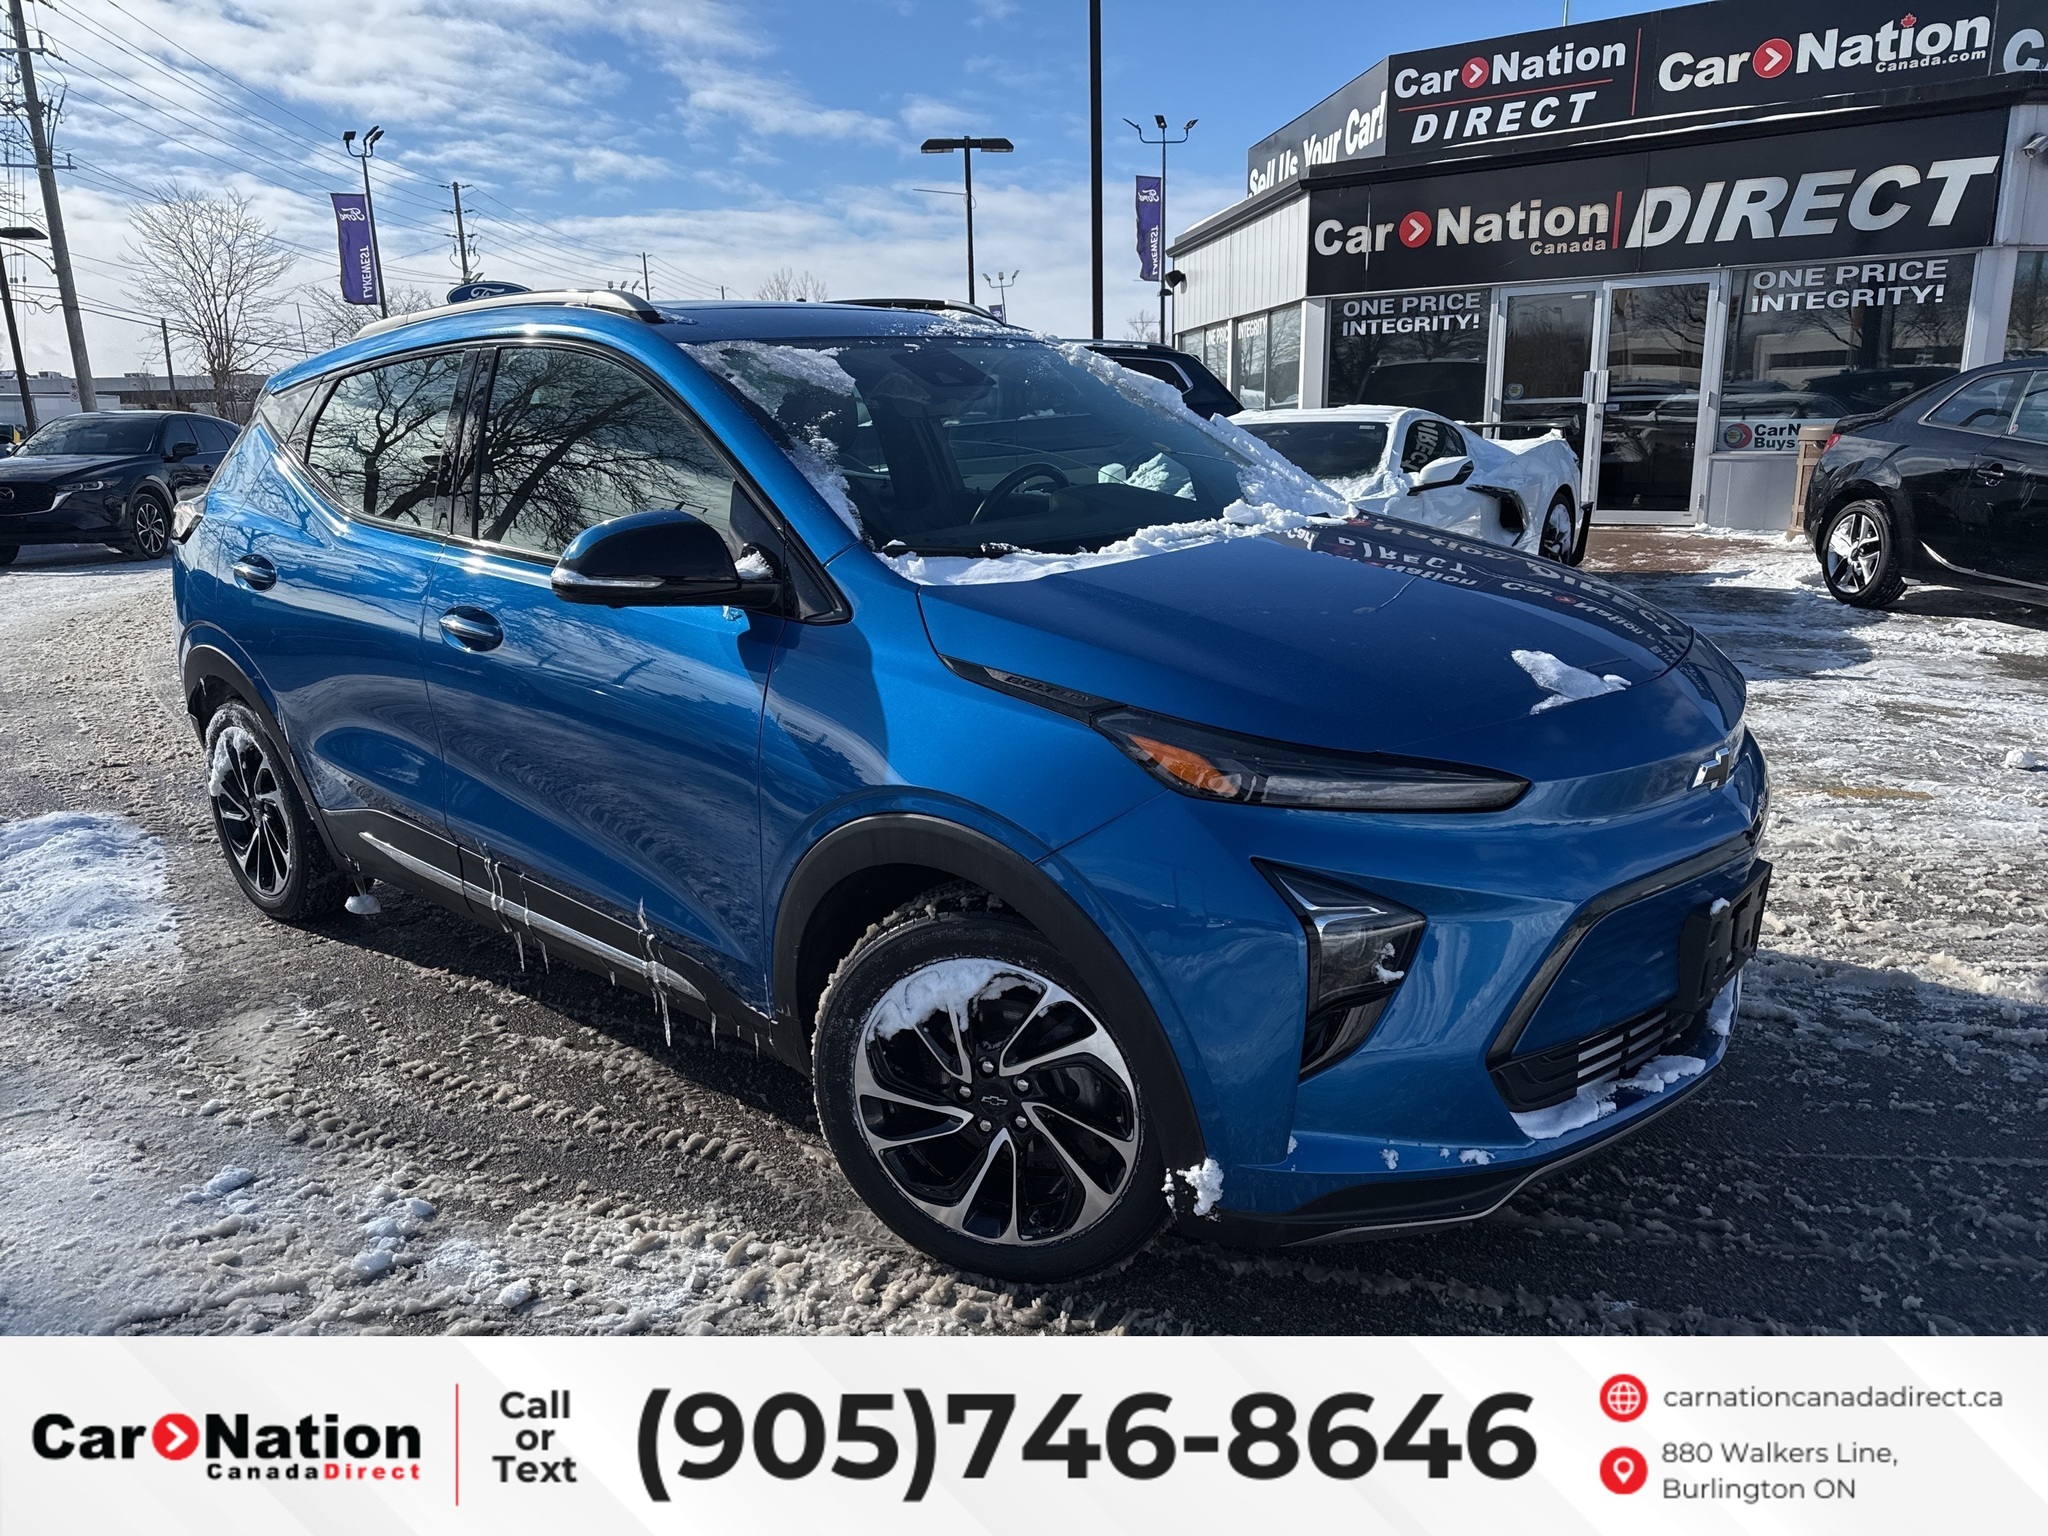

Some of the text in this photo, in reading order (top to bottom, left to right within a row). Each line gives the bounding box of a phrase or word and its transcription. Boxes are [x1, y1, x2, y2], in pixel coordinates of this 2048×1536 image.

[1658, 15, 1991, 92] Car Nation
[1875, 48, 1987, 74] Canada.com
[1394, 42, 1627, 98] Car Nation
[1303, 128, 1342, 168] Your
[1345, 89, 1387, 155] Car!
[1411, 91, 1597, 144] DIRECT
[1314, 155, 2000, 256] Car Nation DIRECT
[1530, 237, 1607, 256] Canada
[1753, 259, 1949, 290] ONE PRICE
[1343, 292, 1481, 318] ONE PRICE
[1751, 284, 1945, 313] INTEGRITY!
[1342, 313, 1480, 337] INTEGRITY!
[1754, 438, 1796, 451] Buys
